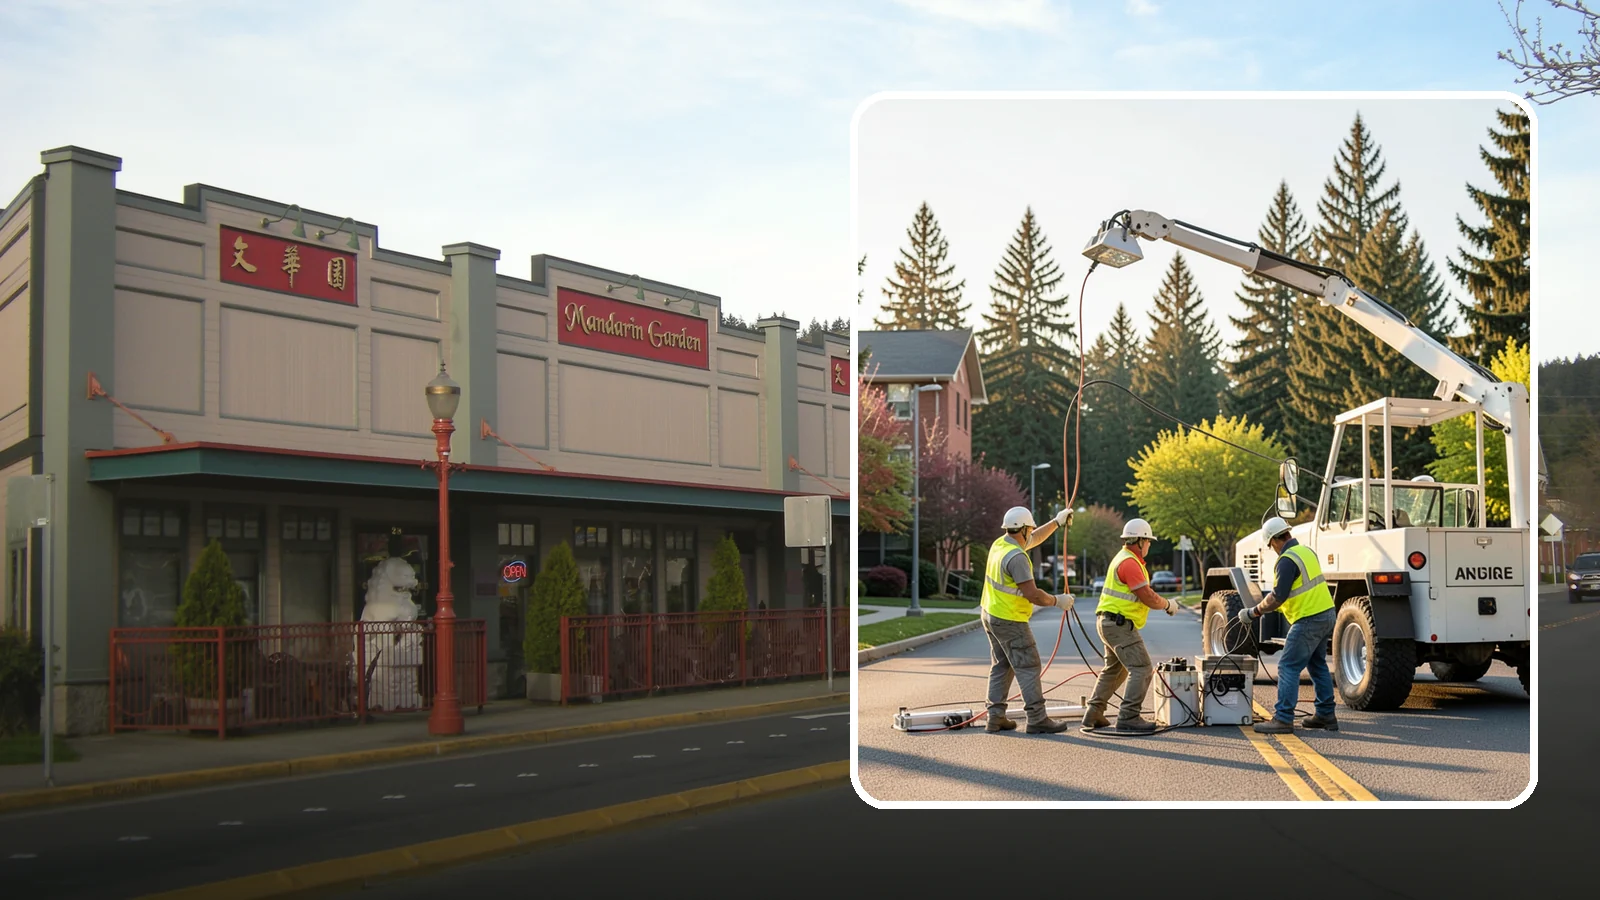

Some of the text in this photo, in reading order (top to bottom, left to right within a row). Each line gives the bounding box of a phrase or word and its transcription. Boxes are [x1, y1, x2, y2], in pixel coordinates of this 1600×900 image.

[564, 302, 702, 352] Mandarin Garden
[503, 565, 527, 578] OPEN
